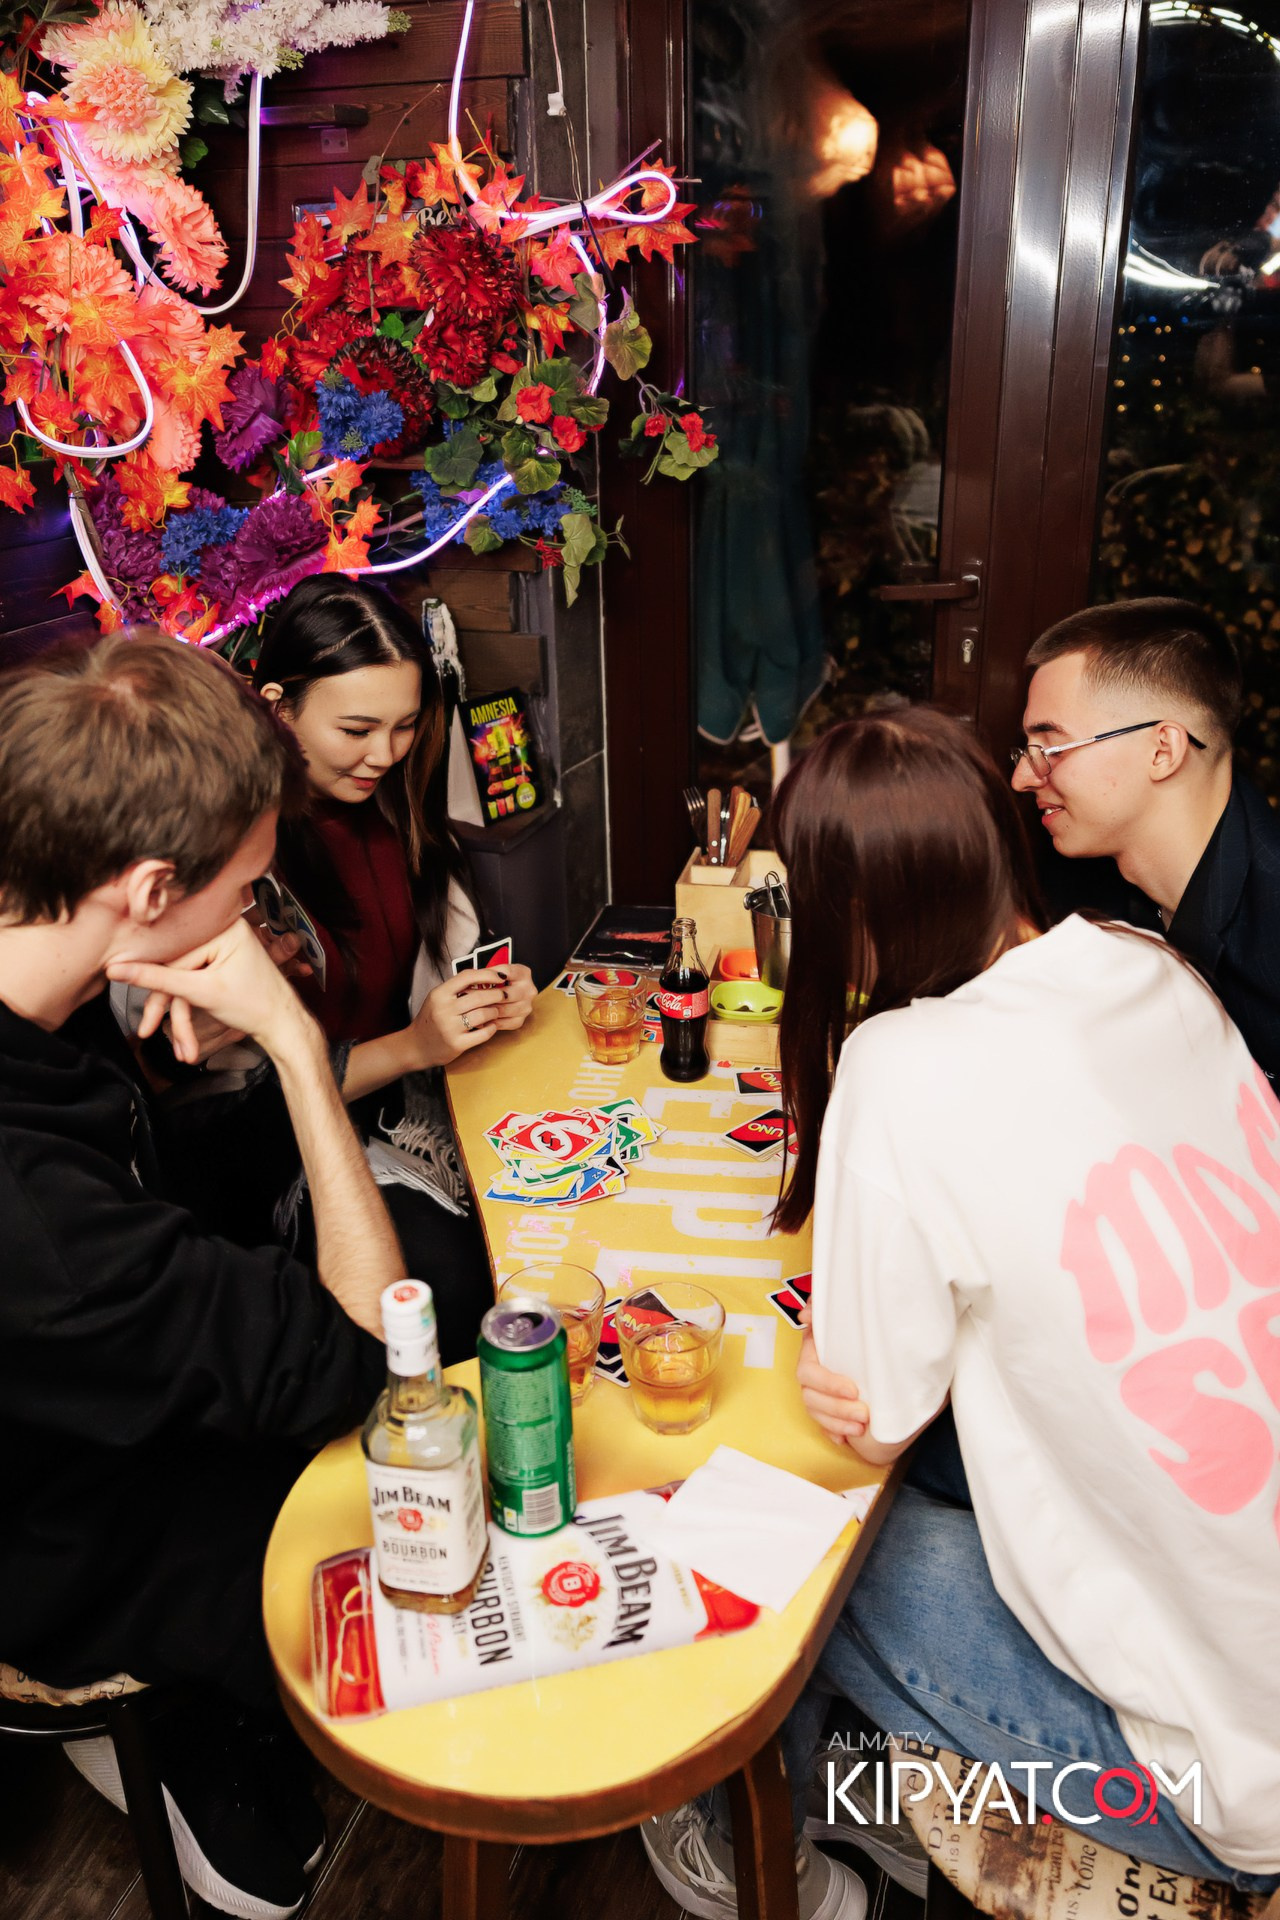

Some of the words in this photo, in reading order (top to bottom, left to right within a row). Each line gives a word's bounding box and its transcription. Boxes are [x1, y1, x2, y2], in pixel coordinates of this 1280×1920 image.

[470, 697, 518, 727] AMNESIA
[747, 1122, 785, 1138] UNO
[371, 1487, 398, 1507] JIM
[402, 1486, 451, 1513] BEAM
[383, 1540, 448, 1560] BOURBON
[571, 1514, 638, 1559] JIM
[602, 1557, 658, 1650] BEAM
